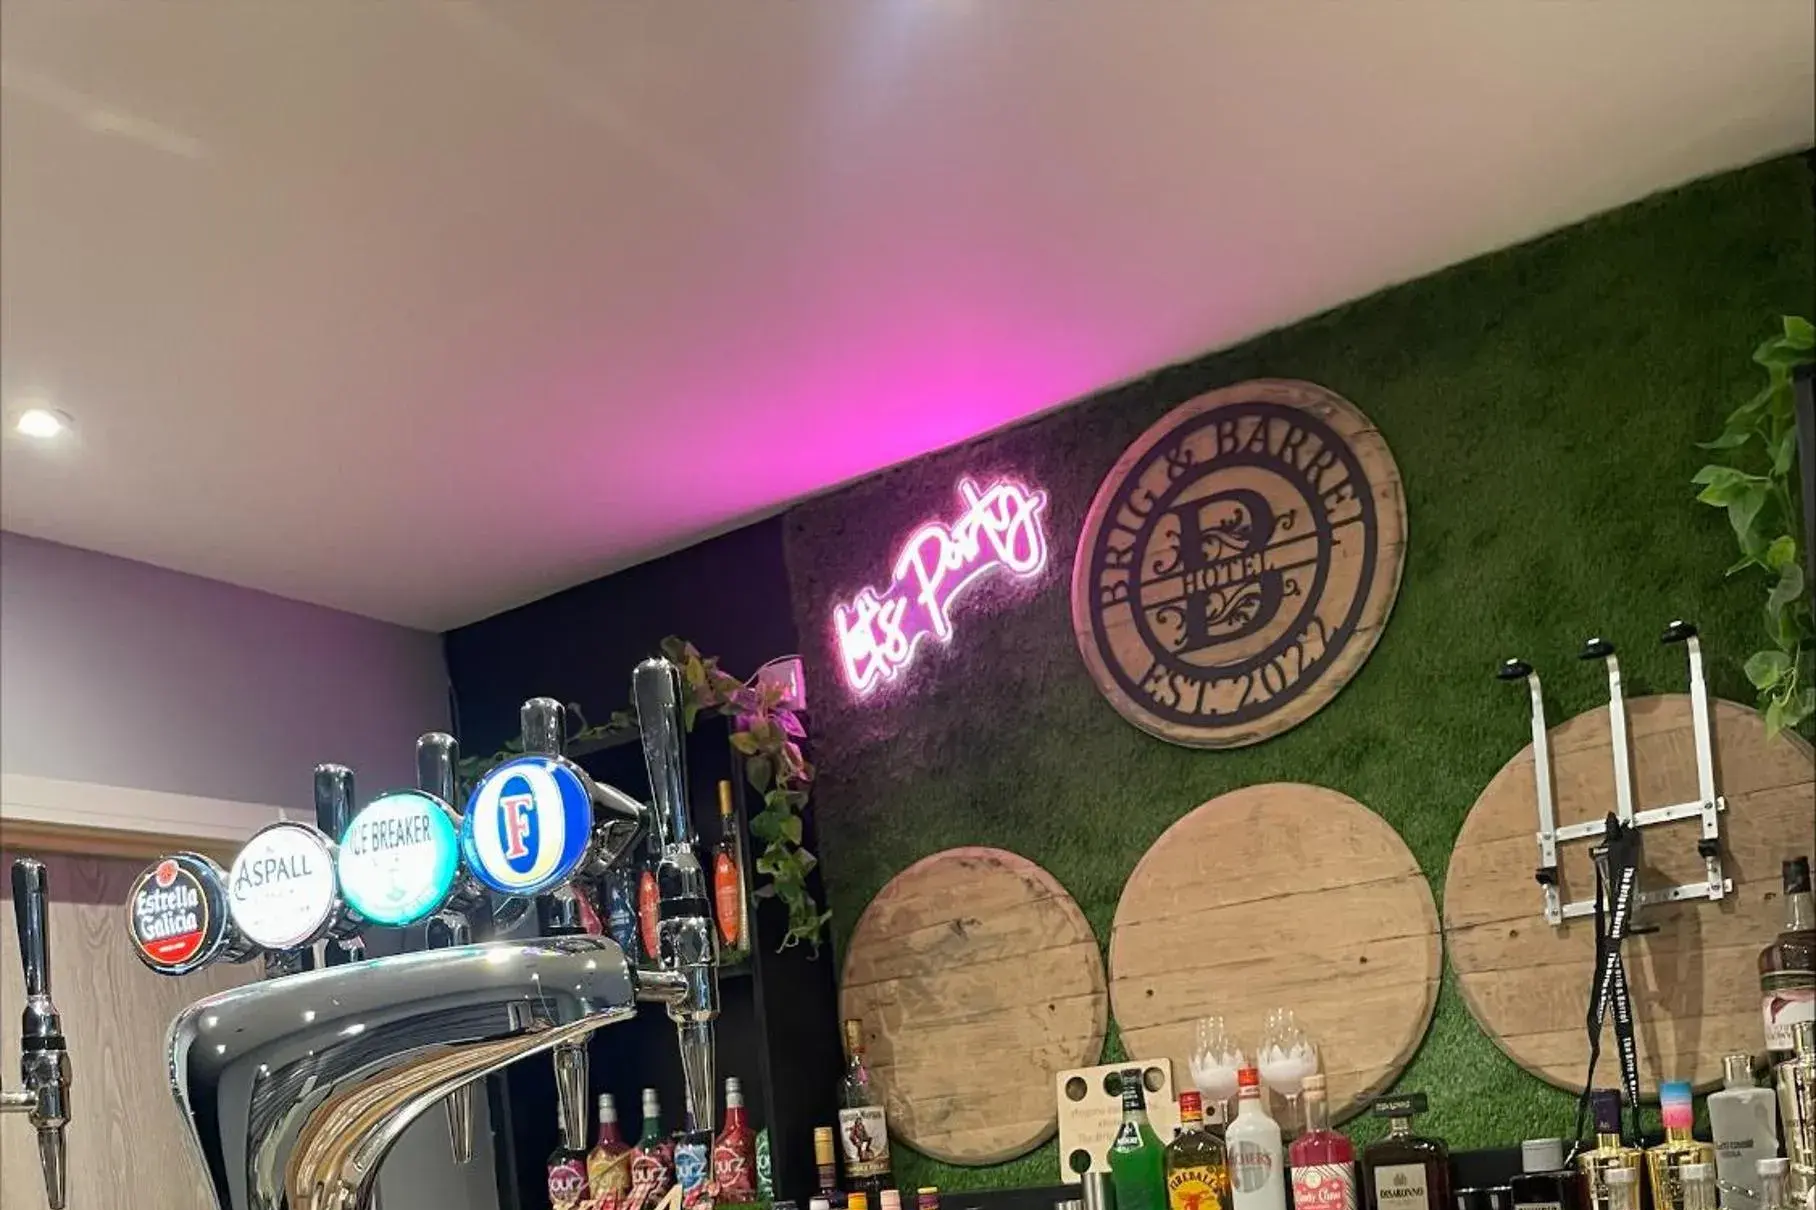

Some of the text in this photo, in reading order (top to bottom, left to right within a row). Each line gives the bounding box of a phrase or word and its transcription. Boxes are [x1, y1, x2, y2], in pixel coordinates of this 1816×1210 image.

[1101, 413, 1365, 604] BRIG & BARREL
[895, 478, 1047, 642] Party
[1183, 551, 1275, 596] HOTEL
[371, 814, 432, 853] BREAKER
[233, 854, 313, 901] ASPALL
[136, 885, 199, 917] Estrella
[141, 909, 198, 940] Galicia
[1380, 1187, 1424, 1199] DISARONNO
